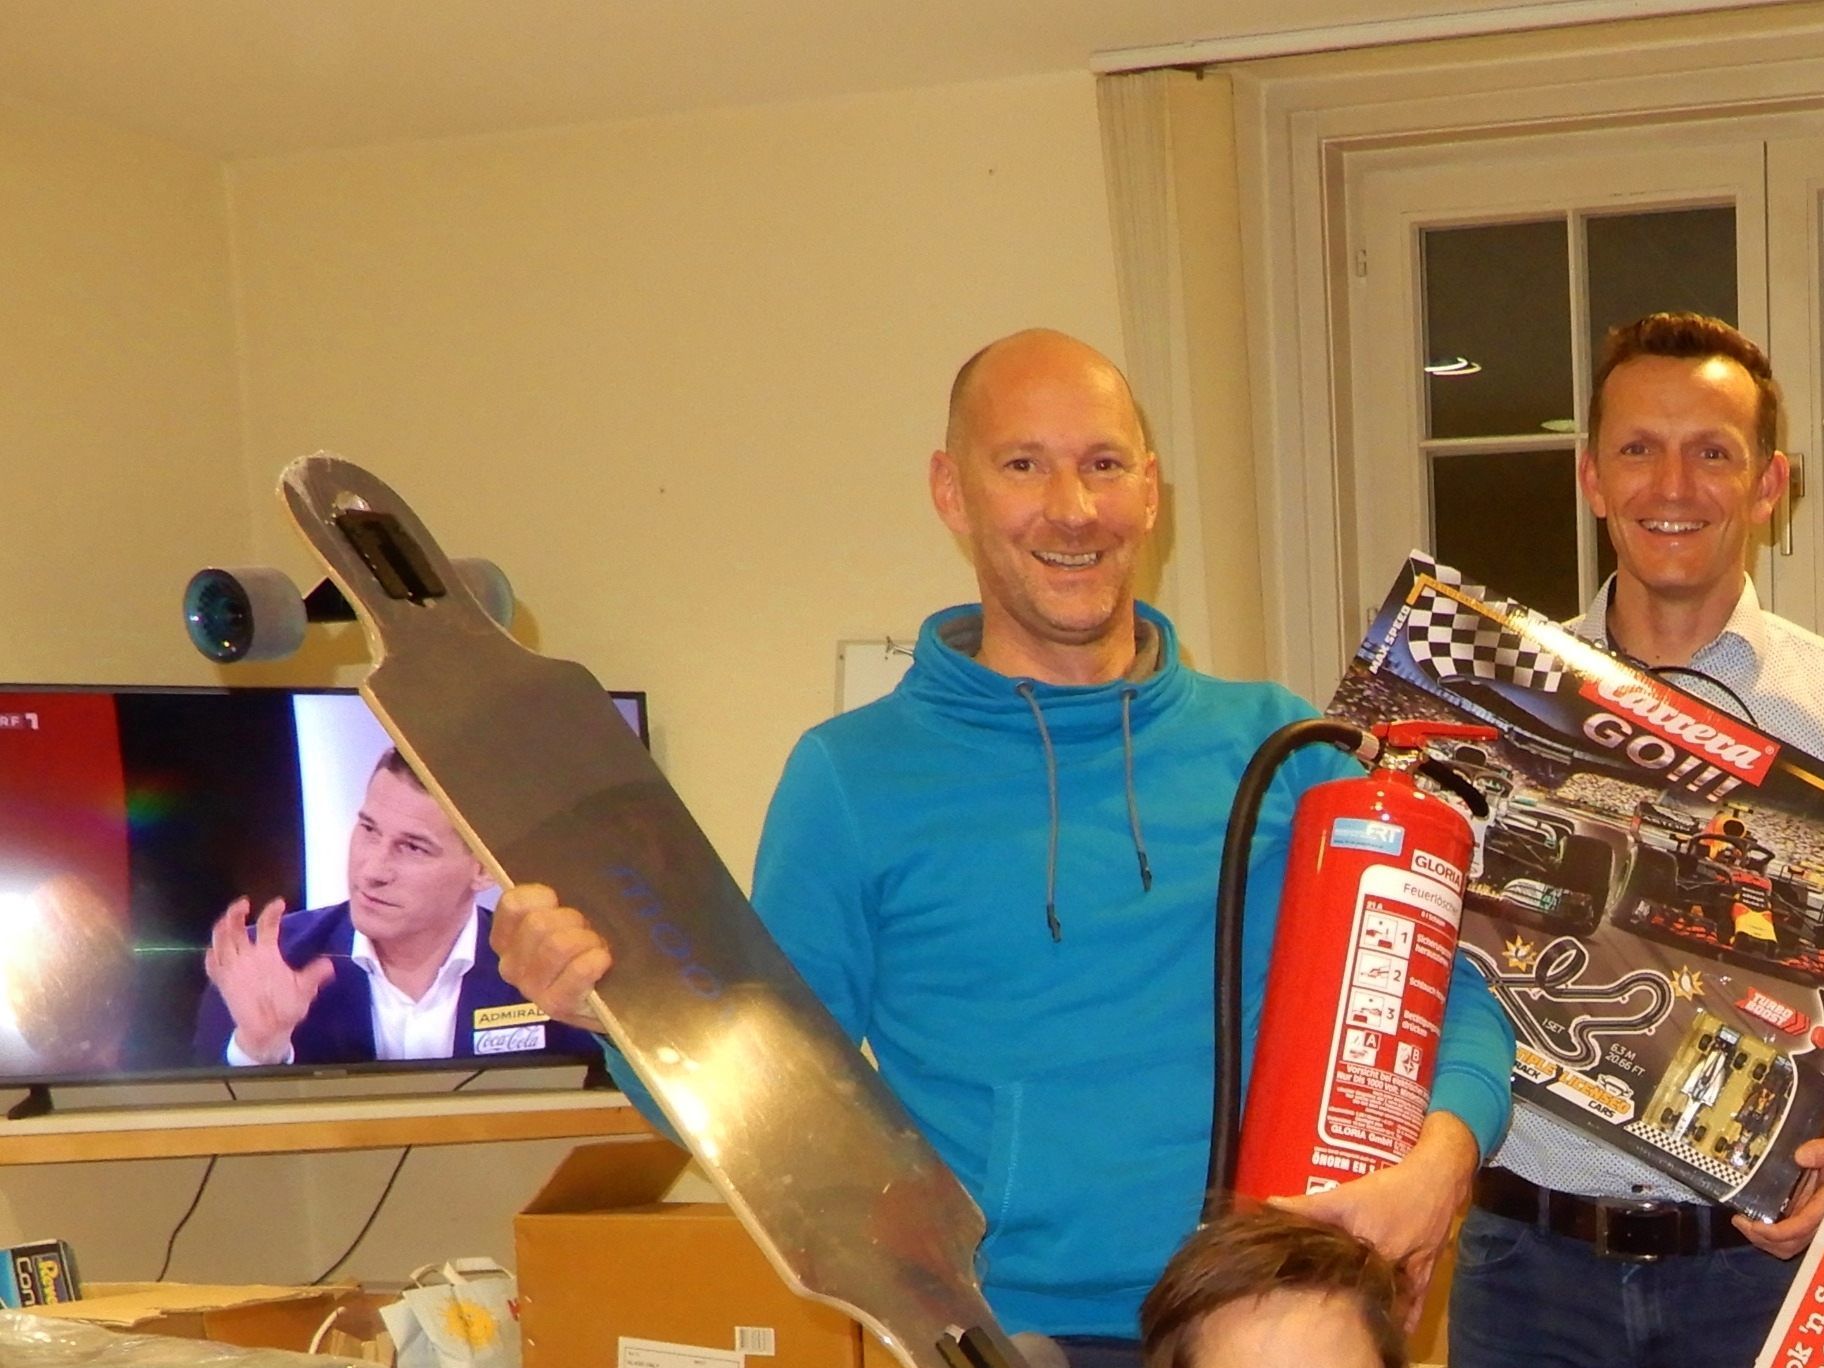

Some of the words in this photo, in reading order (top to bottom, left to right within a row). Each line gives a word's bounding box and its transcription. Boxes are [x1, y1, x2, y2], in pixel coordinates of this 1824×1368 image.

[1369, 644, 1390, 675] MAX
[1384, 604, 1411, 646] SPEED
[1597, 679, 1762, 769] Carrera
[1583, 712, 1742, 802] GO!!!
[1415, 855, 1461, 888] GLORIA
[1401, 932, 1408, 943] 1
[1393, 970, 1401, 982] 2
[1386, 1008, 1395, 1020] 3
[1744, 1000, 1785, 1027] BOOST
[1752, 992, 1794, 1017] TURBO
[1545, 1020, 1565, 1034] SET
[1366, 1034, 1377, 1048] A
[1610, 1043, 1627, 1057] 6.3
[1626, 1049, 1637, 1060] M
[1412, 1049, 1420, 1061] B
[1605, 1051, 1631, 1070] 20.66
[1632, 1065, 1646, 1077] FT
[1559, 1071, 1631, 1115] LICENSED
[1588, 1100, 1616, 1119] CARS
[1330, 1125, 1367, 1140] GLORIA
[1368, 1134, 1393, 1147] GmbH
[1311, 1151, 1350, 1170] ÖNORM
[1352, 1161, 1366, 1174] EN
